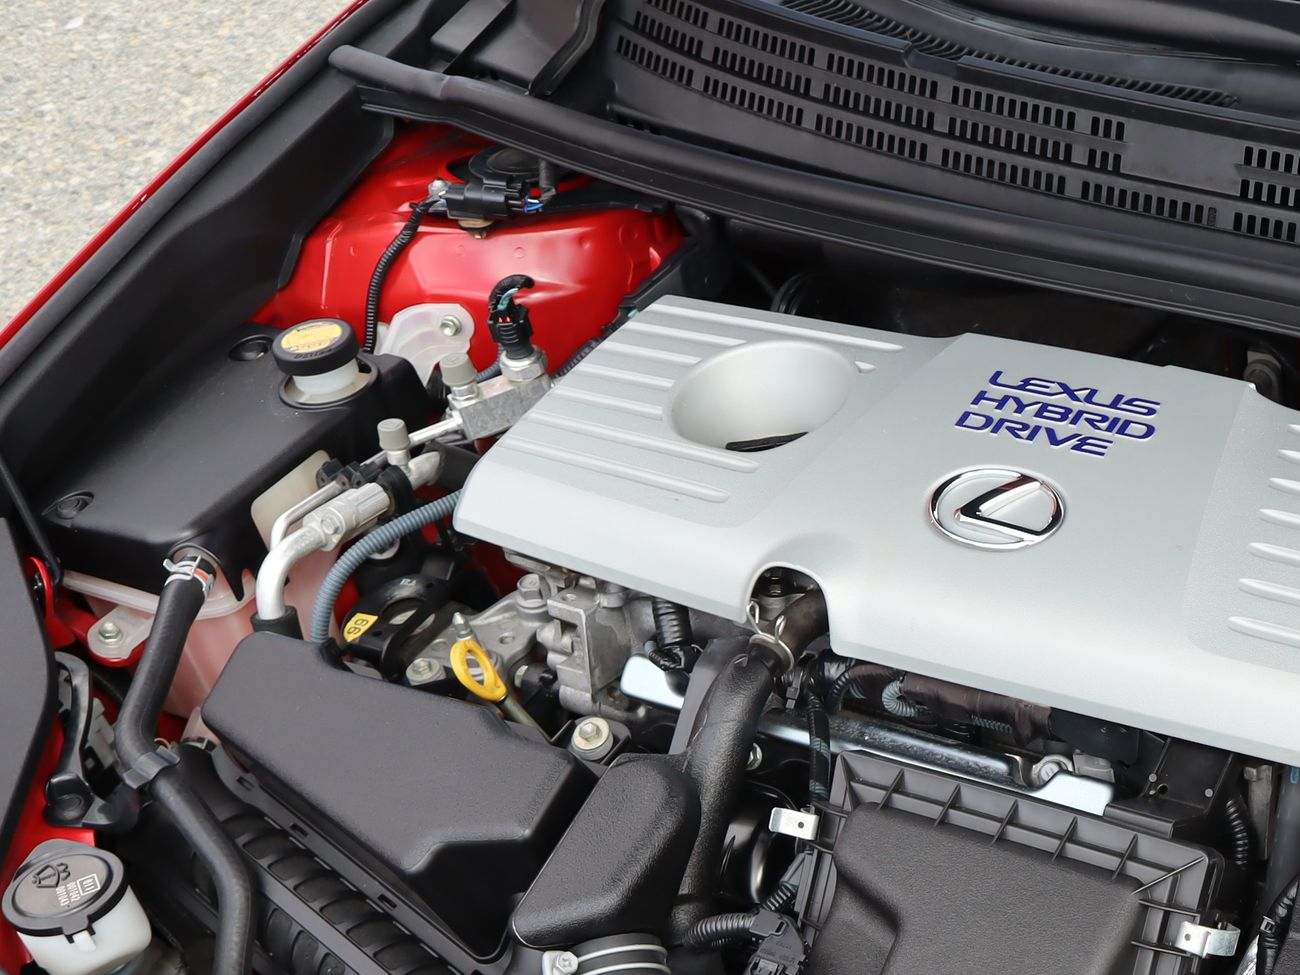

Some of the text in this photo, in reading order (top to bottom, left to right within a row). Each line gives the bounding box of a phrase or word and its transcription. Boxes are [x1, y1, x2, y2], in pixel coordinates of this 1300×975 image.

[970, 390, 1156, 440] HYBRID
[988, 370, 1161, 417] LEXUS
[954, 411, 1114, 457] DRIVE
